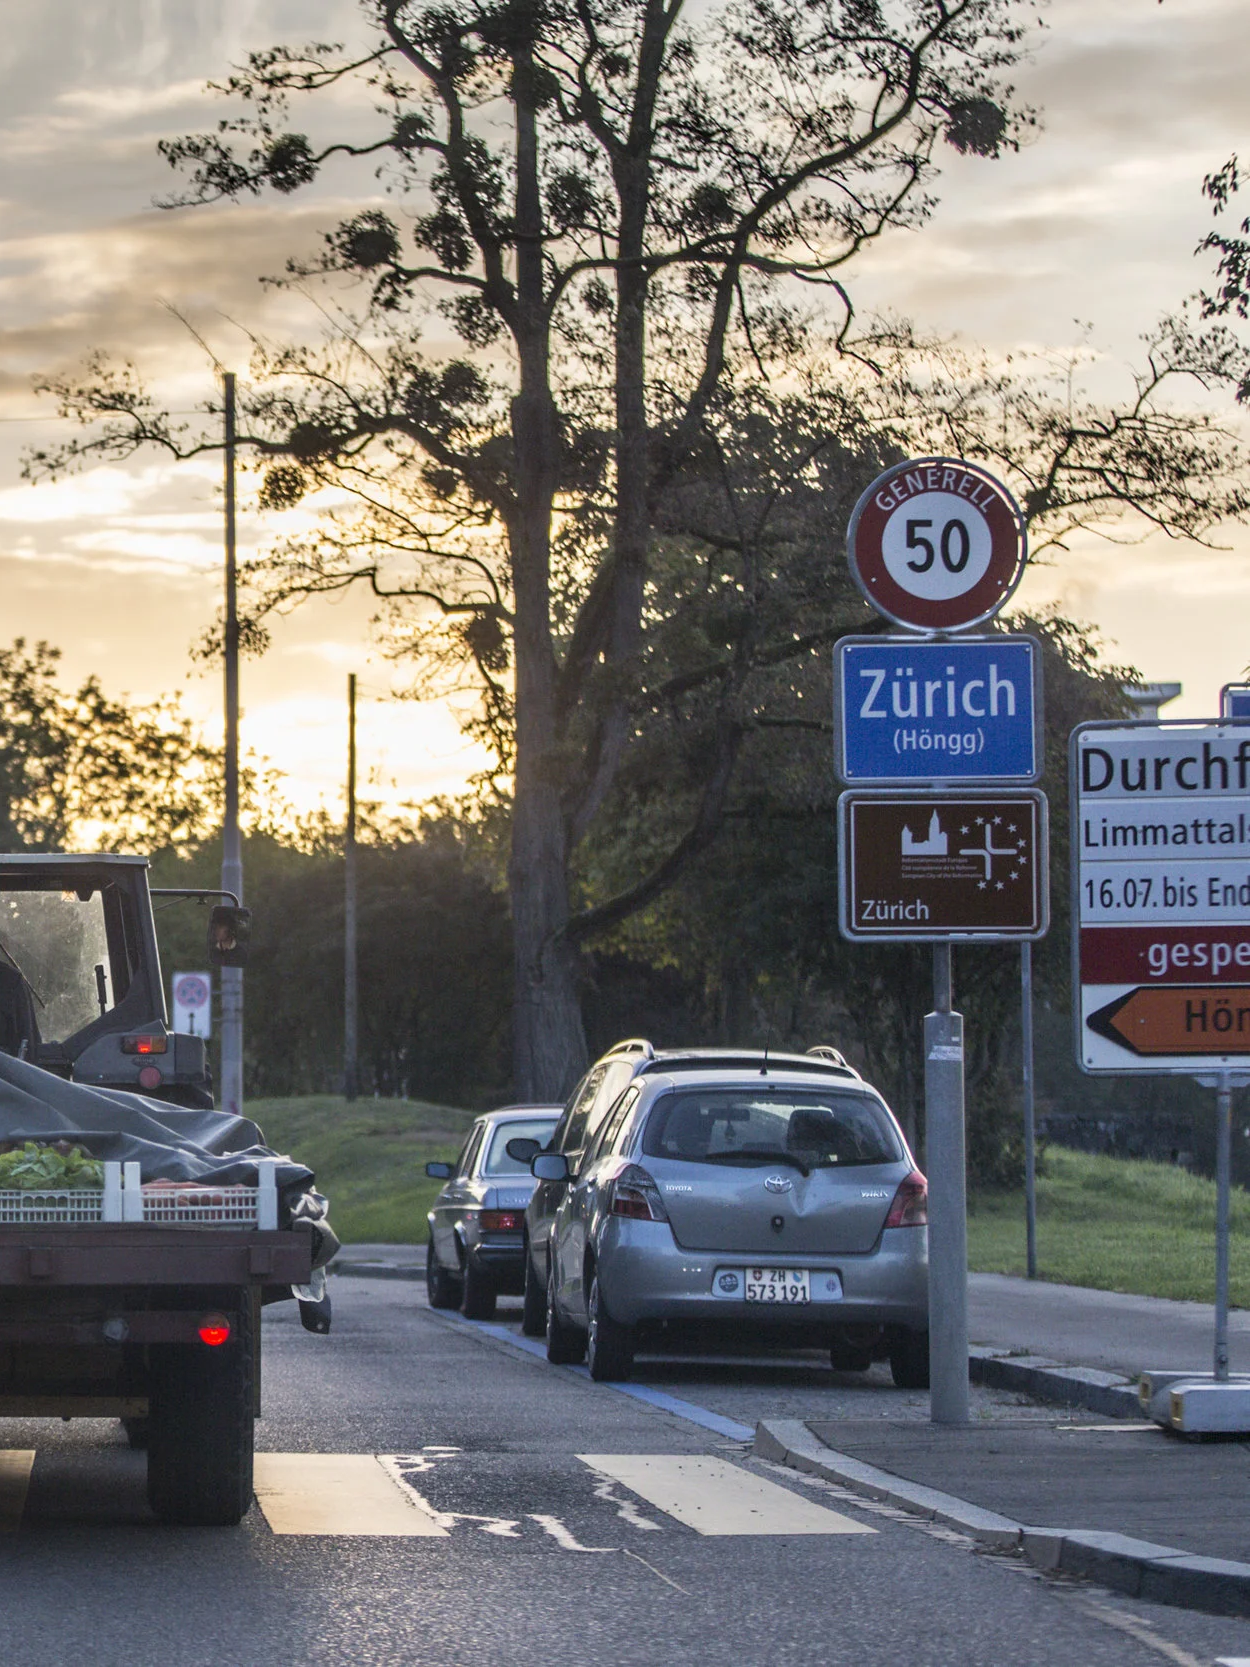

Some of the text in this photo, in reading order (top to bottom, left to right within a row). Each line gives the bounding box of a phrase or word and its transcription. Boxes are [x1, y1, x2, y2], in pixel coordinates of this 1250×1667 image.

[875, 468, 997, 513] GENERELL
[906, 518, 970, 574] 50
[859, 663, 1016, 718] Zürich
[893, 727, 985, 755] (Höngg)
[1082, 740, 1250, 792] Durchf
[1084, 813, 1250, 848] Limmattal
[1208, 875, 1250, 907] End
[861, 899, 929, 920] Zürich
[1148, 942, 1250, 976] gespe
[665, 1184, 693, 1192] TOYOTA
[747, 1283, 808, 1301] 573 191
[770, 1270, 786, 1282] ZH
